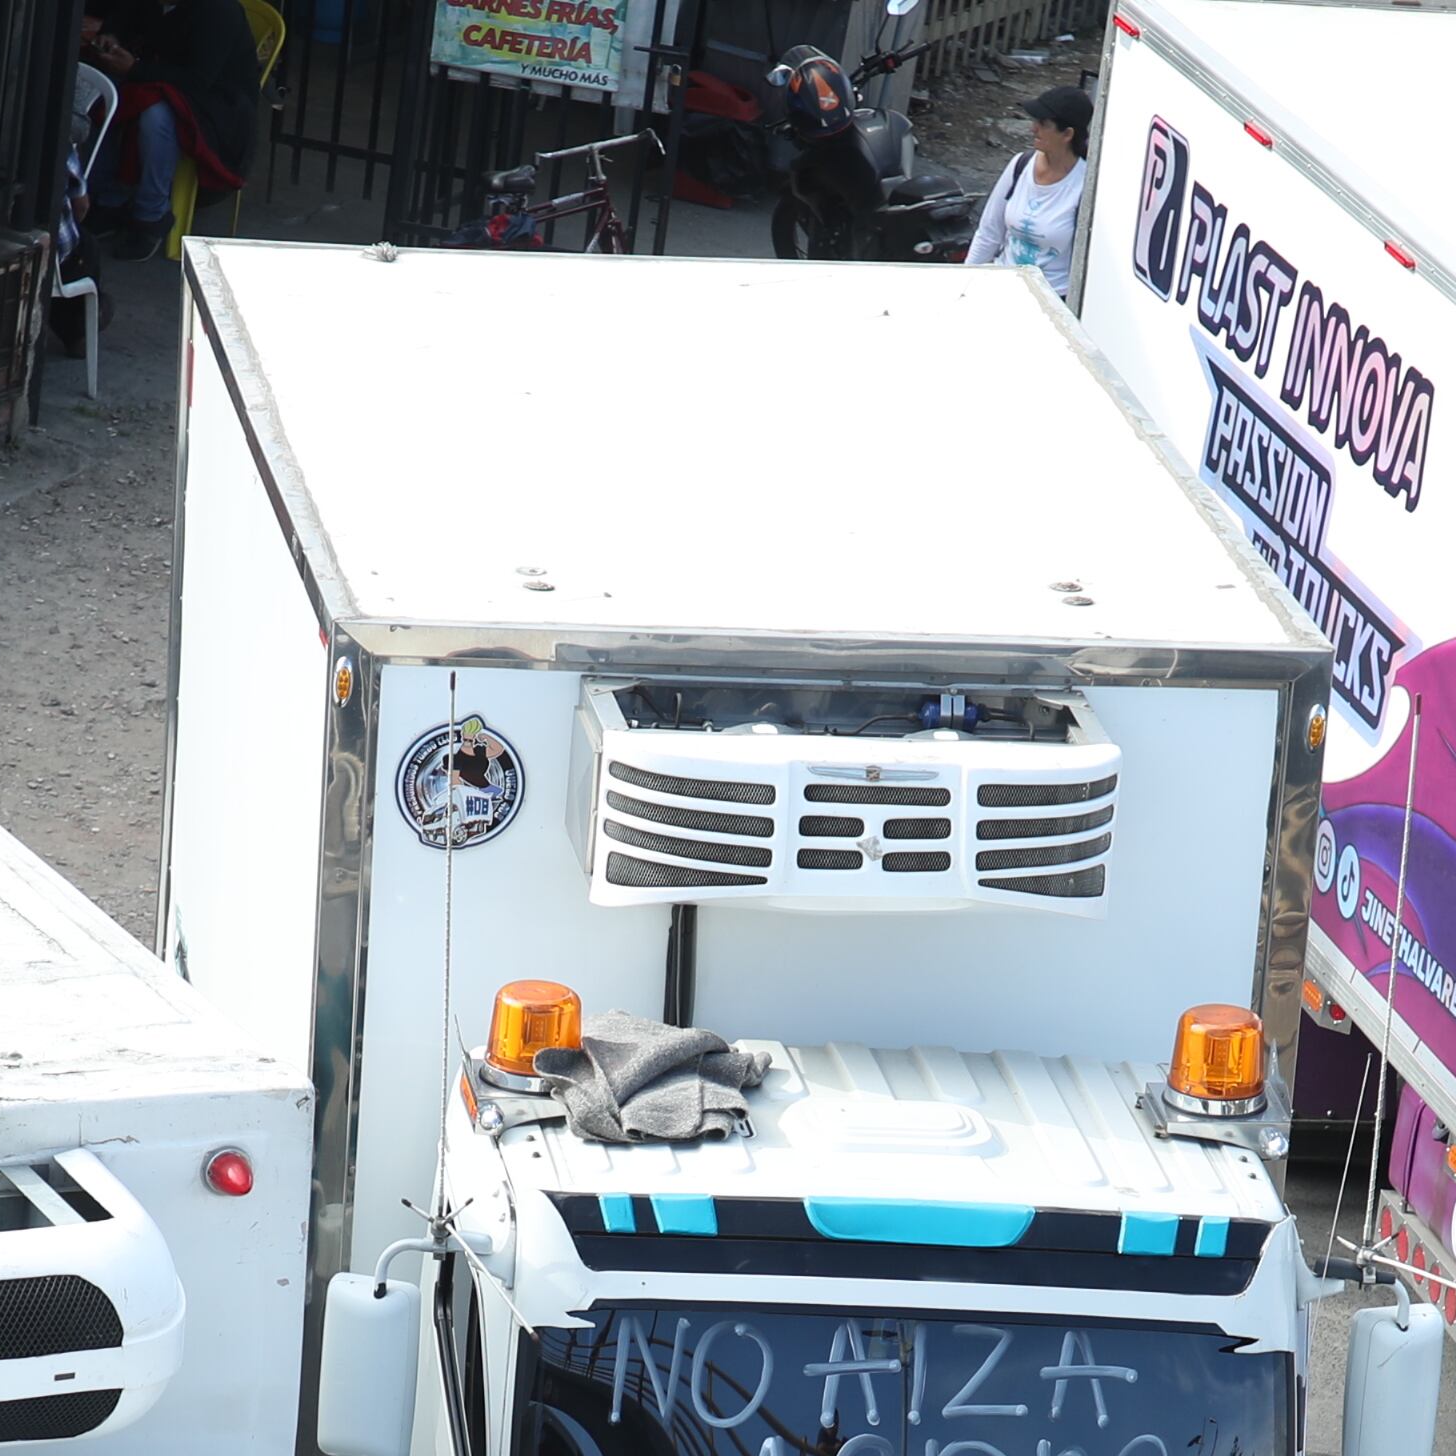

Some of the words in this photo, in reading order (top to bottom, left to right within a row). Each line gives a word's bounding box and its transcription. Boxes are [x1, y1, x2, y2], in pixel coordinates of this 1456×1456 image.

[463, 25, 592, 64] CAFETERÍA
[520, 63, 529, 74] Y
[530, 65, 579, 81] MUCHO
[580, 72, 609, 86] MÁS
[1176, 181, 1298, 379] PLAST
[1280, 280, 1434, 512] INNOVA
[1211, 385, 1329, 558] PASSION
[609, 1317, 774, 1428] NO
